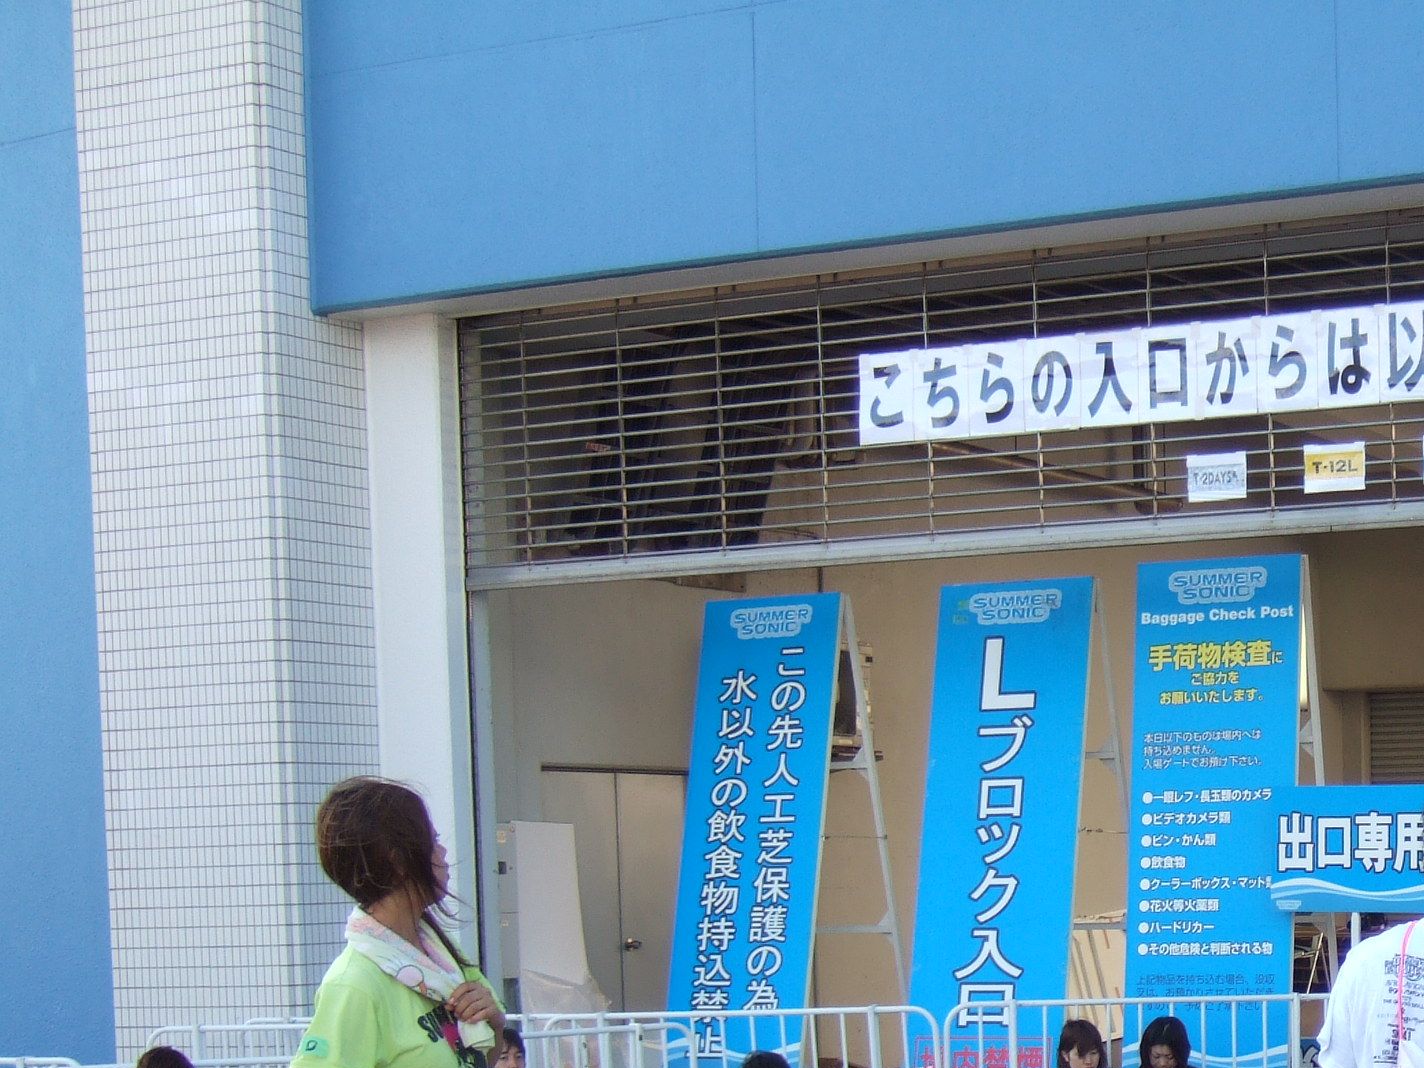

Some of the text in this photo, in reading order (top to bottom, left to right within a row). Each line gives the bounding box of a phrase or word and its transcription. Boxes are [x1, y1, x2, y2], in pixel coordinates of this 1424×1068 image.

[1174, 571, 1264, 587] SUMMER
[1183, 585, 1250, 600] SONIC
[974, 593, 1058, 609] SUMMER
[734, 608, 809, 624] SUMMER
[982, 607, 1044, 621] SONIC
[1141, 605, 1294, 625] Baggage Check Post
[741, 621, 796, 635] SONIC
[1149, 640, 1284, 672] 手荷物検査に
[1191, 671, 1240, 686] ご協力を
[1159, 689, 1264, 706] お願いいたします。
[1152, 811, 1231, 826] ビデオカメラ類
[743, 646, 807, 1011] この先人工芝保護の為
[953, 635, 1036, 1027] Lブロック入口
[686, 669, 758, 1058] 水以外の飲食物持込禁止
[1151, 855, 1186, 869] 飲食物
[1149, 920, 1215, 934] ハードリカー
